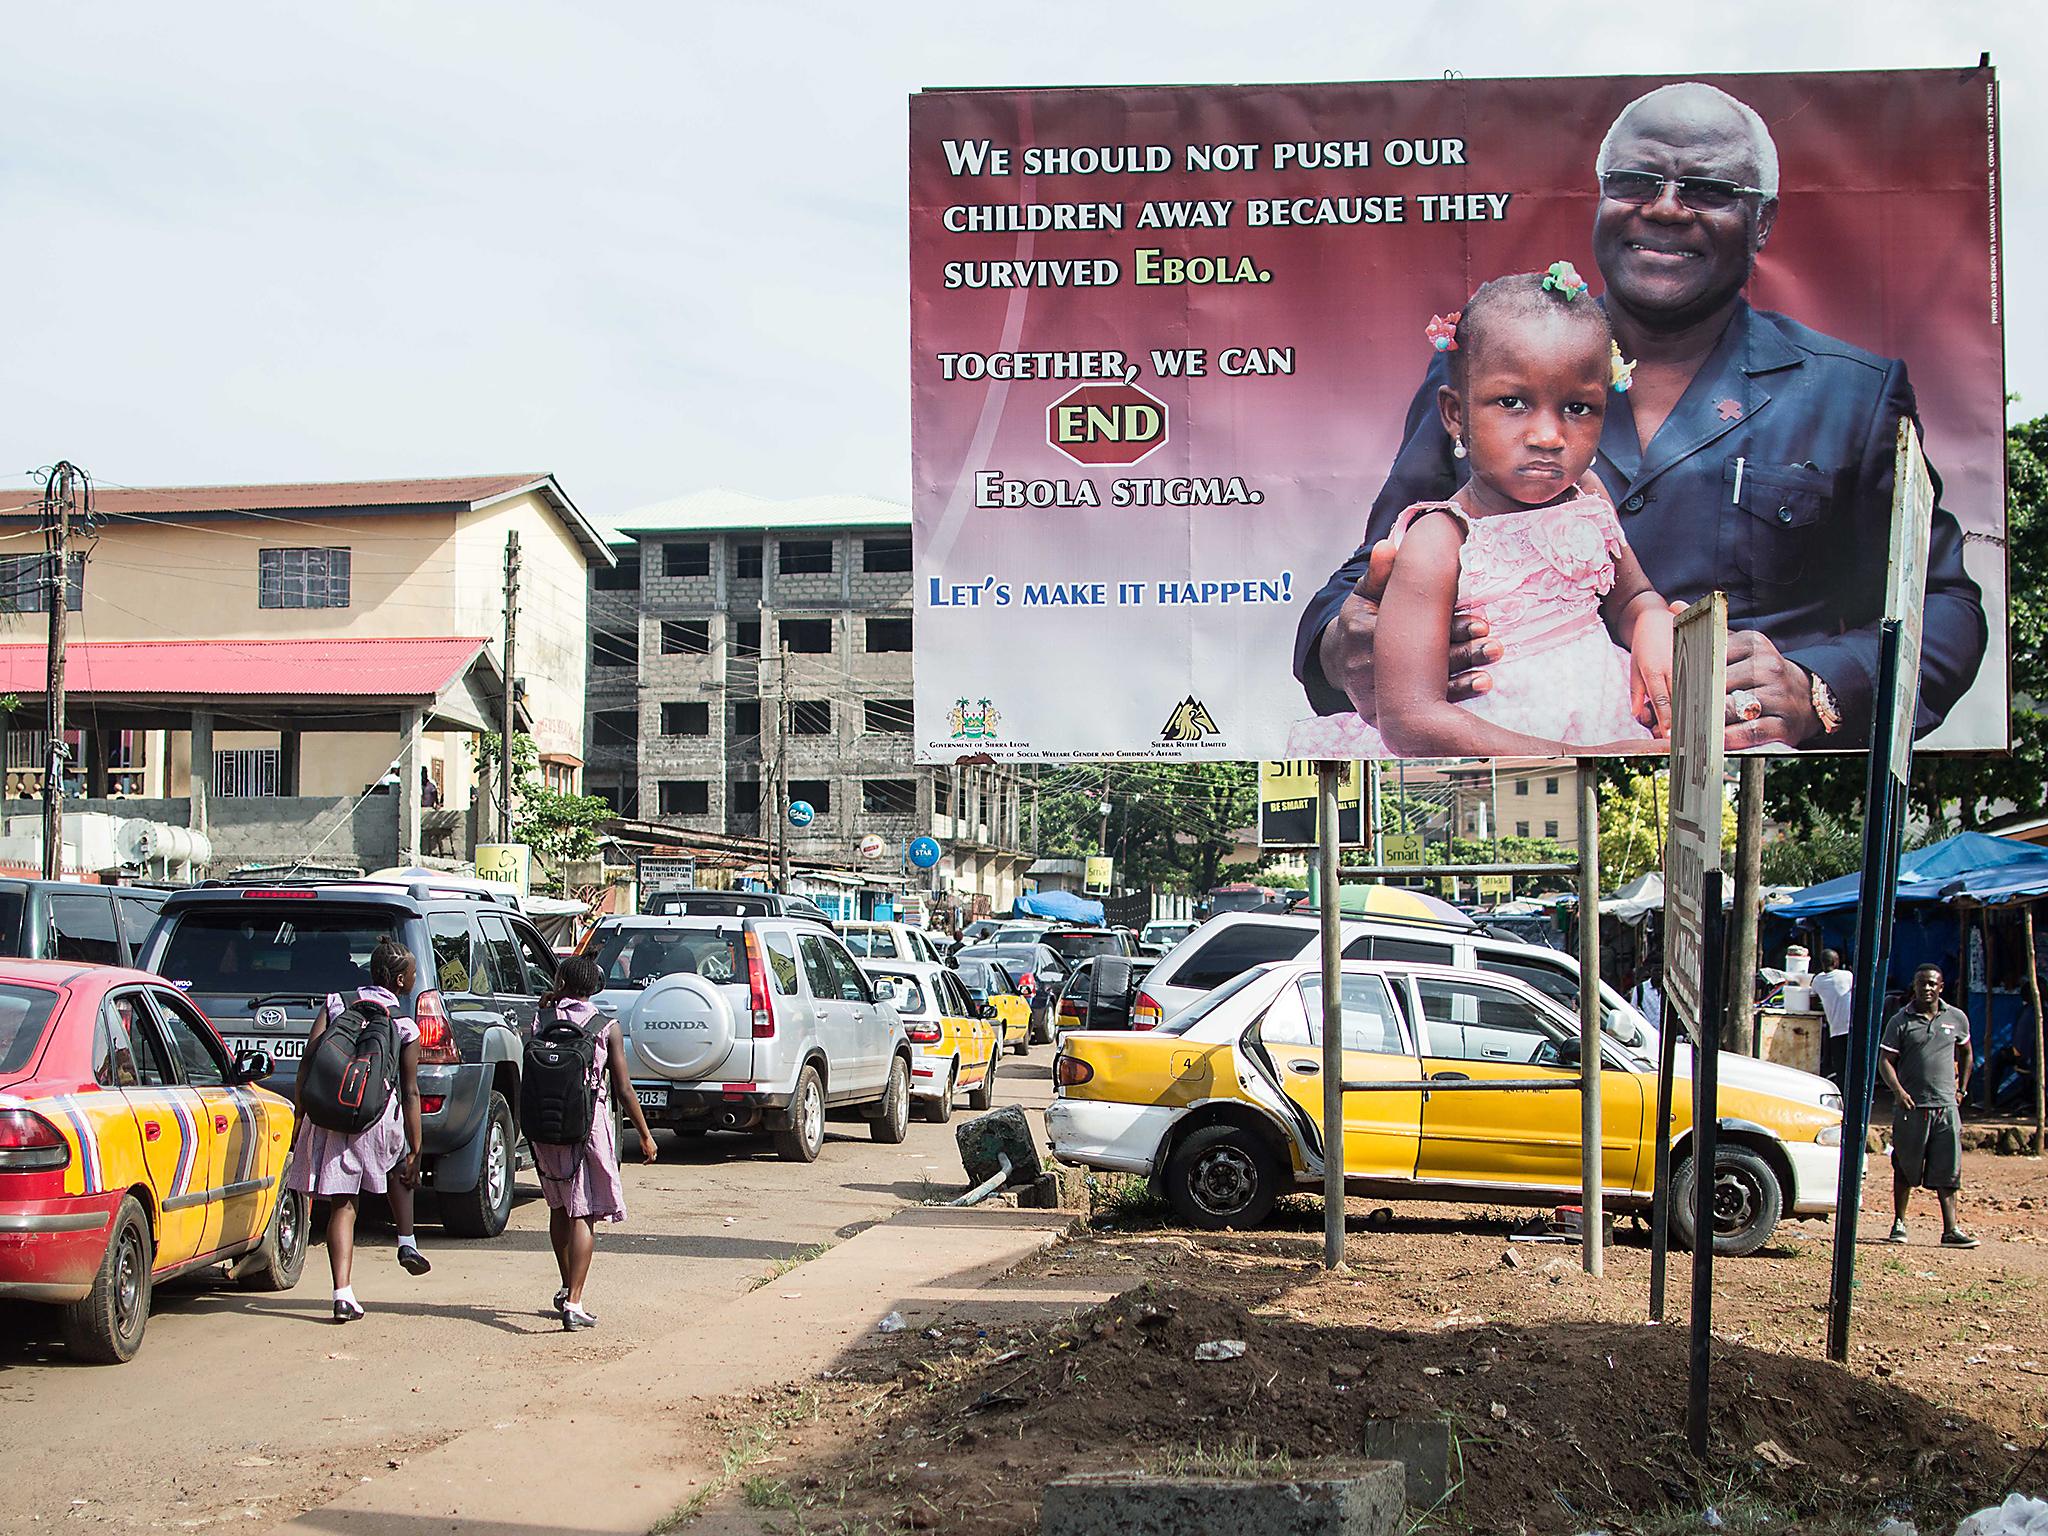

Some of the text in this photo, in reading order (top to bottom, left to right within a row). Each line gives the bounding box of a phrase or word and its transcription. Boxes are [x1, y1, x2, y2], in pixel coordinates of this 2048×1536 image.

[1023, 146, 1172, 175] SHOULD
[1186, 143, 1259, 172] NOT
[1273, 140, 1369, 169] PUSH
[1383, 137, 1466, 166] OUR
[943, 193, 1510, 232] CHILDREN AWAY BECAUSE THEY
[944, 259, 1119, 288] SURVIVED
[938, 347, 1294, 385] TOGETHER, WE CAN
[1058, 405, 1161, 442] END
[1112, 477, 1264, 506] STIGMA.
[1022, 583, 1107, 606] MAKE
[1118, 583, 1145, 605] IT
[1158, 571, 1293, 604] HAPPEN!
[1270, 802, 1281, 812] BE
[1281, 799, 1309, 811] SMART
[1386, 848, 1419, 861] Smart
[478, 867, 518, 883] Smart
[644, 1021, 709, 1030] HONDA
[1183, 1058, 1192, 1069] 4
